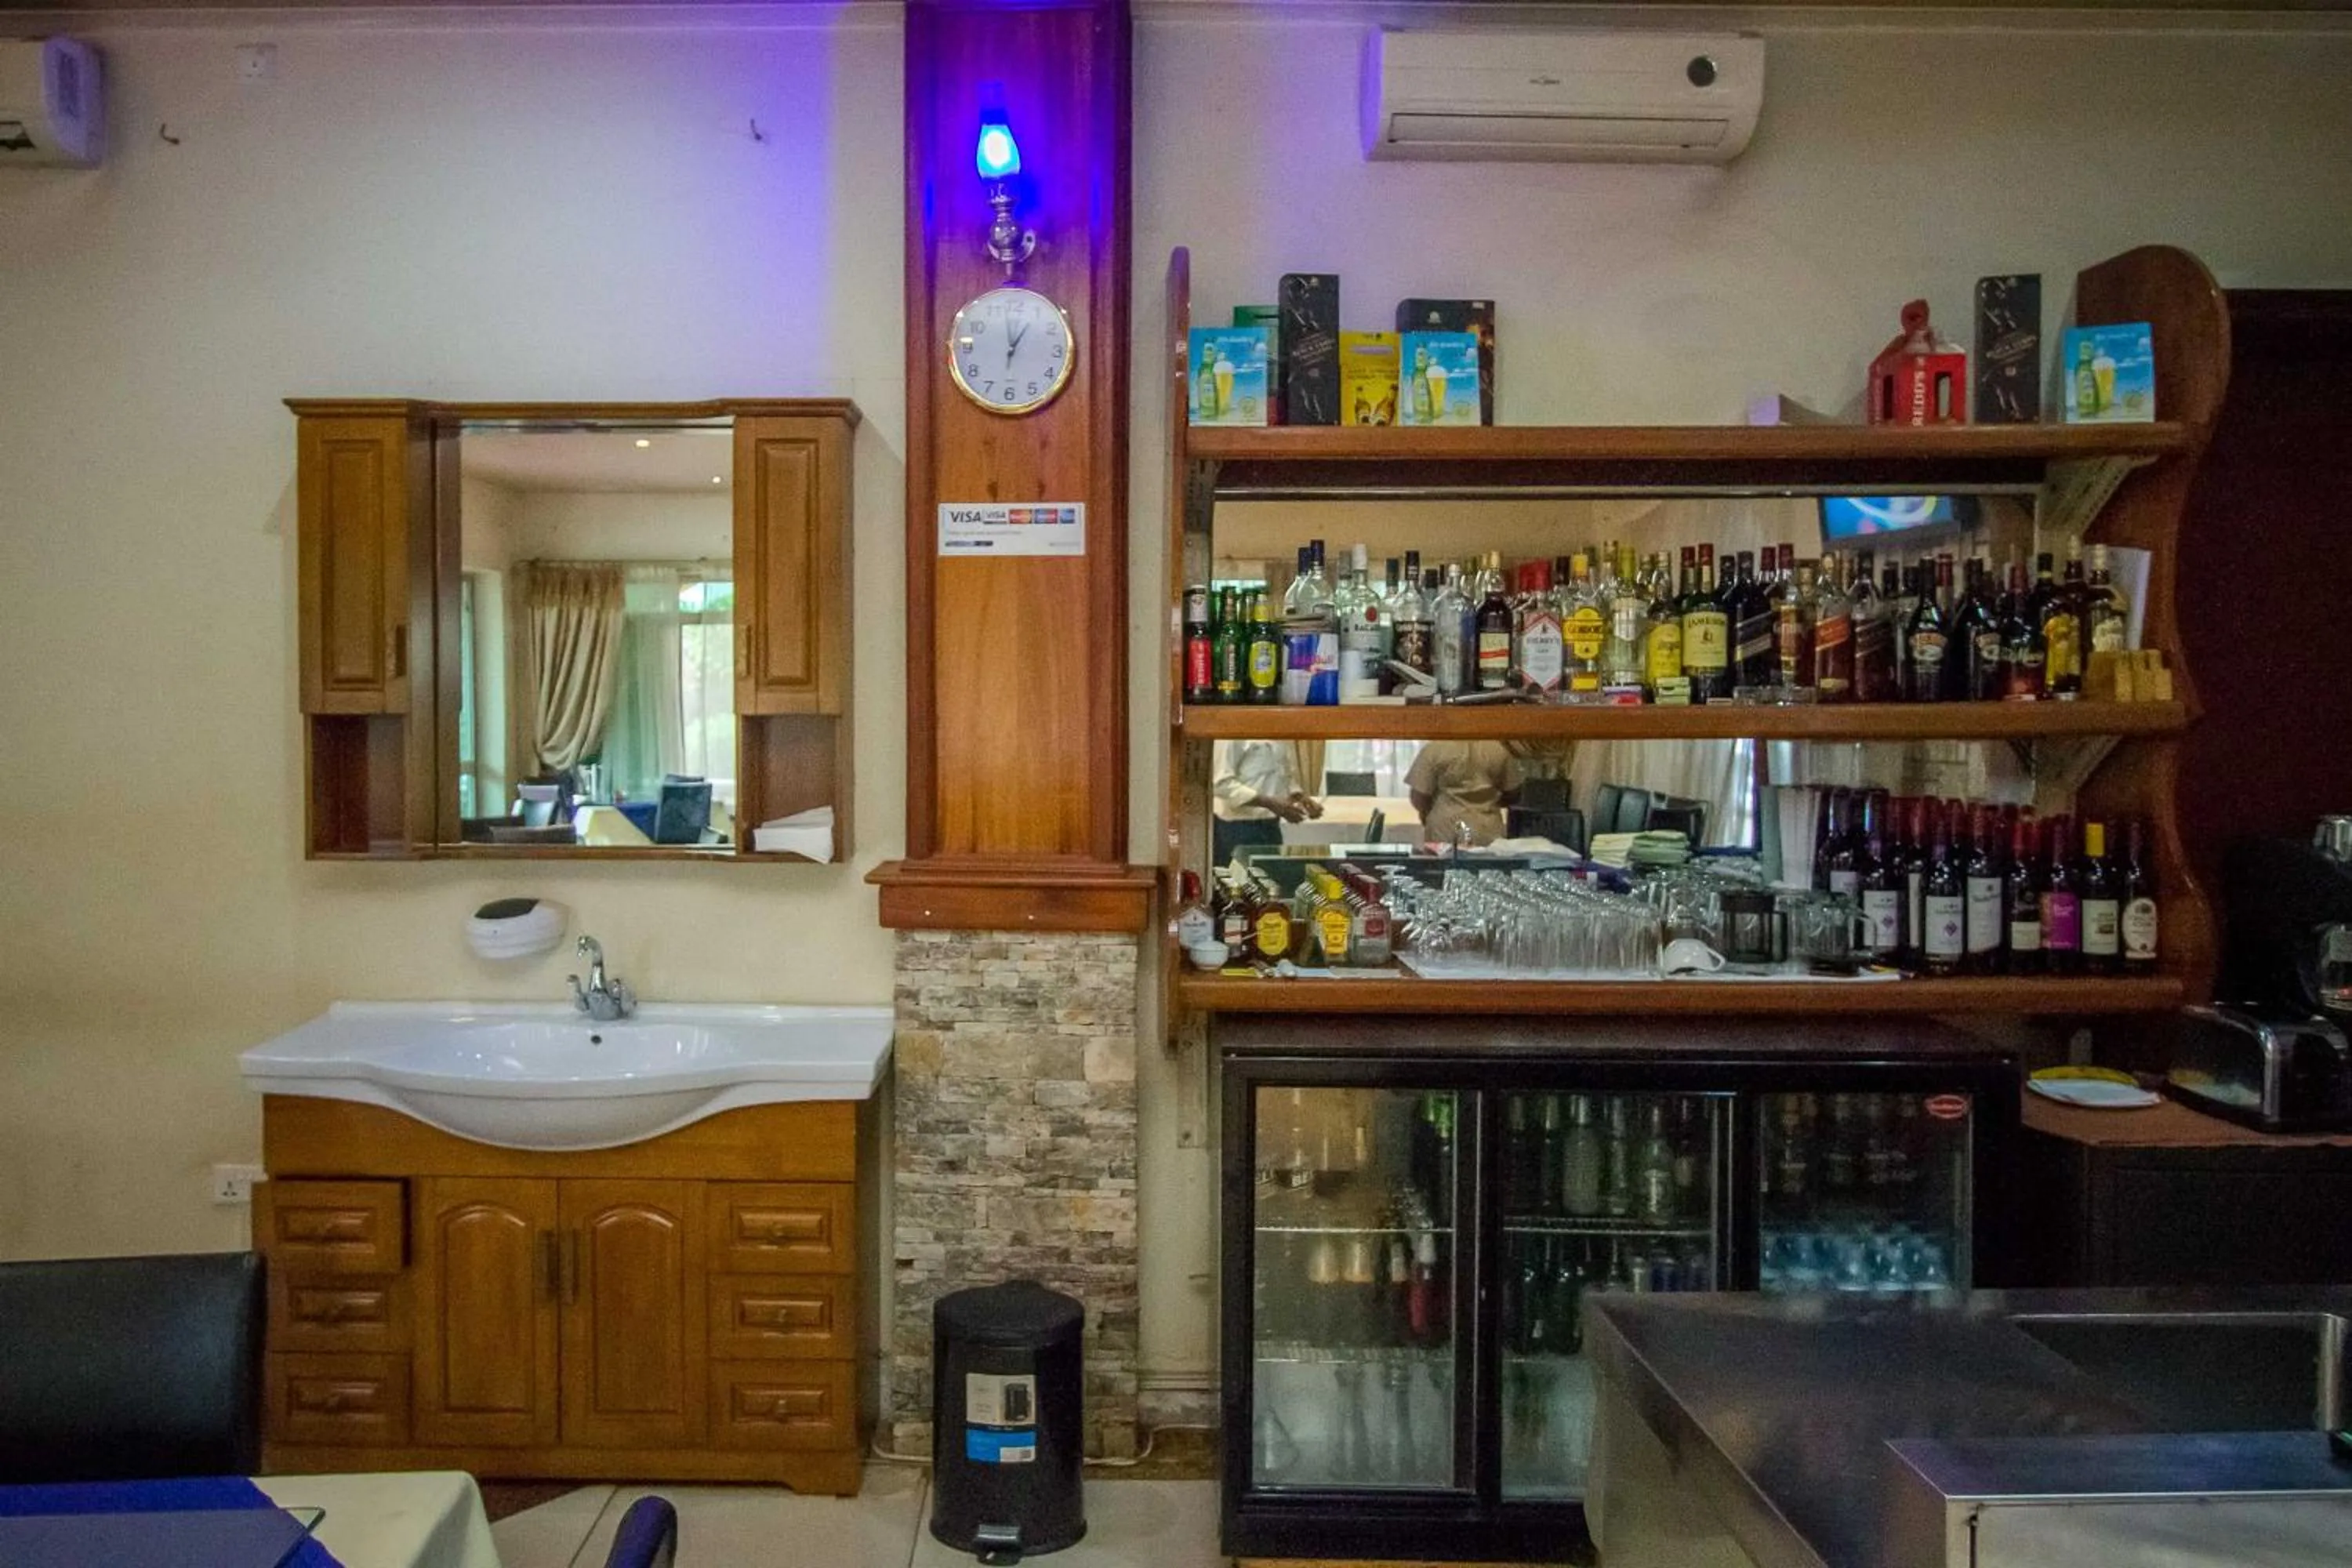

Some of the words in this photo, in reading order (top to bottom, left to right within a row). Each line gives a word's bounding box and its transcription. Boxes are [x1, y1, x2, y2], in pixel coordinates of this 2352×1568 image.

[987, 305, 1002, 317] 11
[1006, 300, 1024, 312] 12
[1036, 306, 1040, 318] 1
[970, 321, 985, 334] 10
[1046, 322, 1056, 336] 2
[962, 341, 973, 354] 9
[1052, 345, 1062, 358] 3
[967, 364, 978, 377] 8
[1044, 366, 1054, 379] 4
[984, 380, 994, 393] 7
[1028, 382, 1037, 395] 5
[1004, 387, 1014, 401] 6
[950, 510, 981, 523] VISA
[985, 510, 1006, 519] VISA
